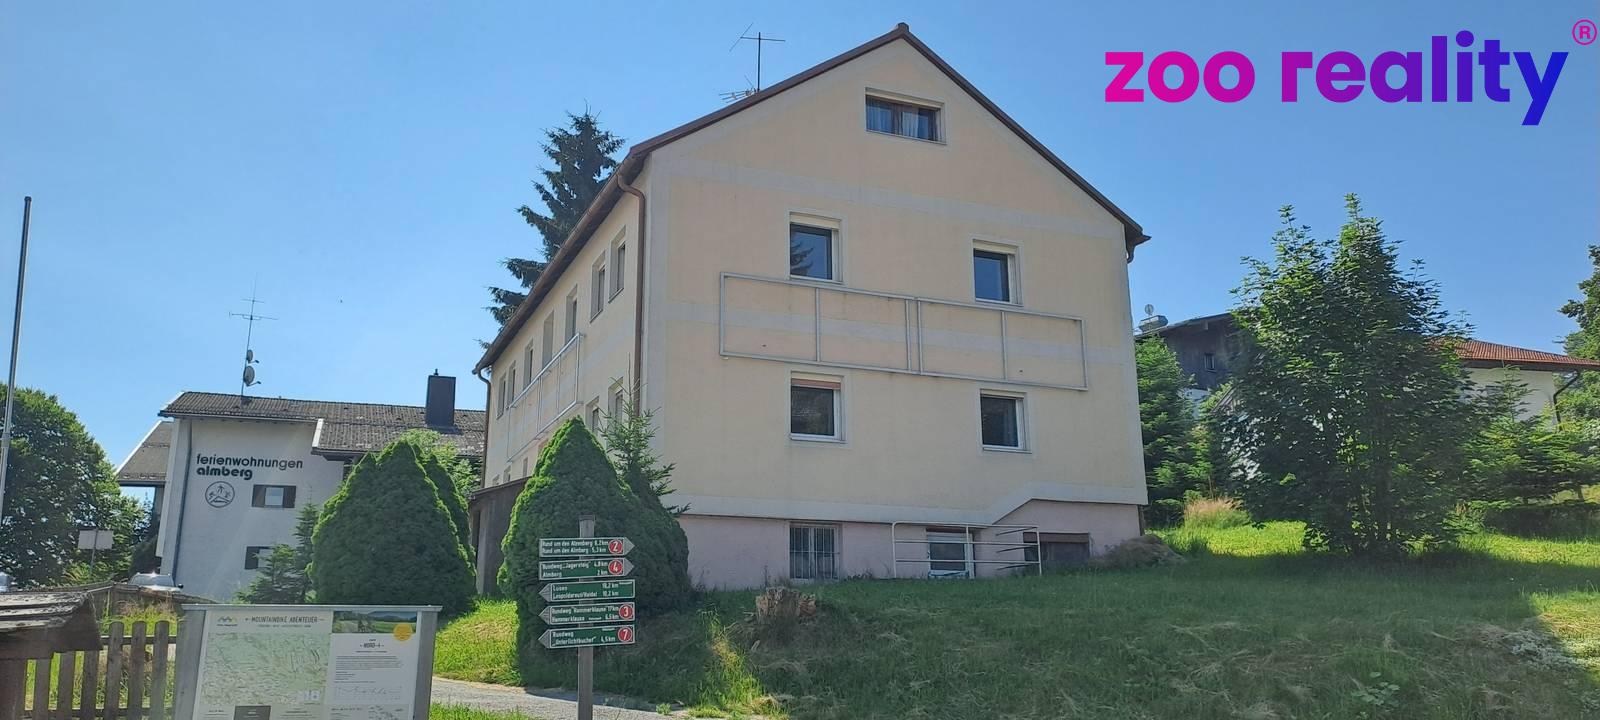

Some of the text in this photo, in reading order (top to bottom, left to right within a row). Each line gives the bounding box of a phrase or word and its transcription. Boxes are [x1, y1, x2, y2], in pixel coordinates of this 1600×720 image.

[197, 454, 303, 471] ferienwohnungen
[196, 466, 253, 480] almberg
[612, 540, 619, 552] 2
[613, 561, 618, 573] 4
[624, 606, 629, 617] 3
[622, 629, 628, 640] 7
